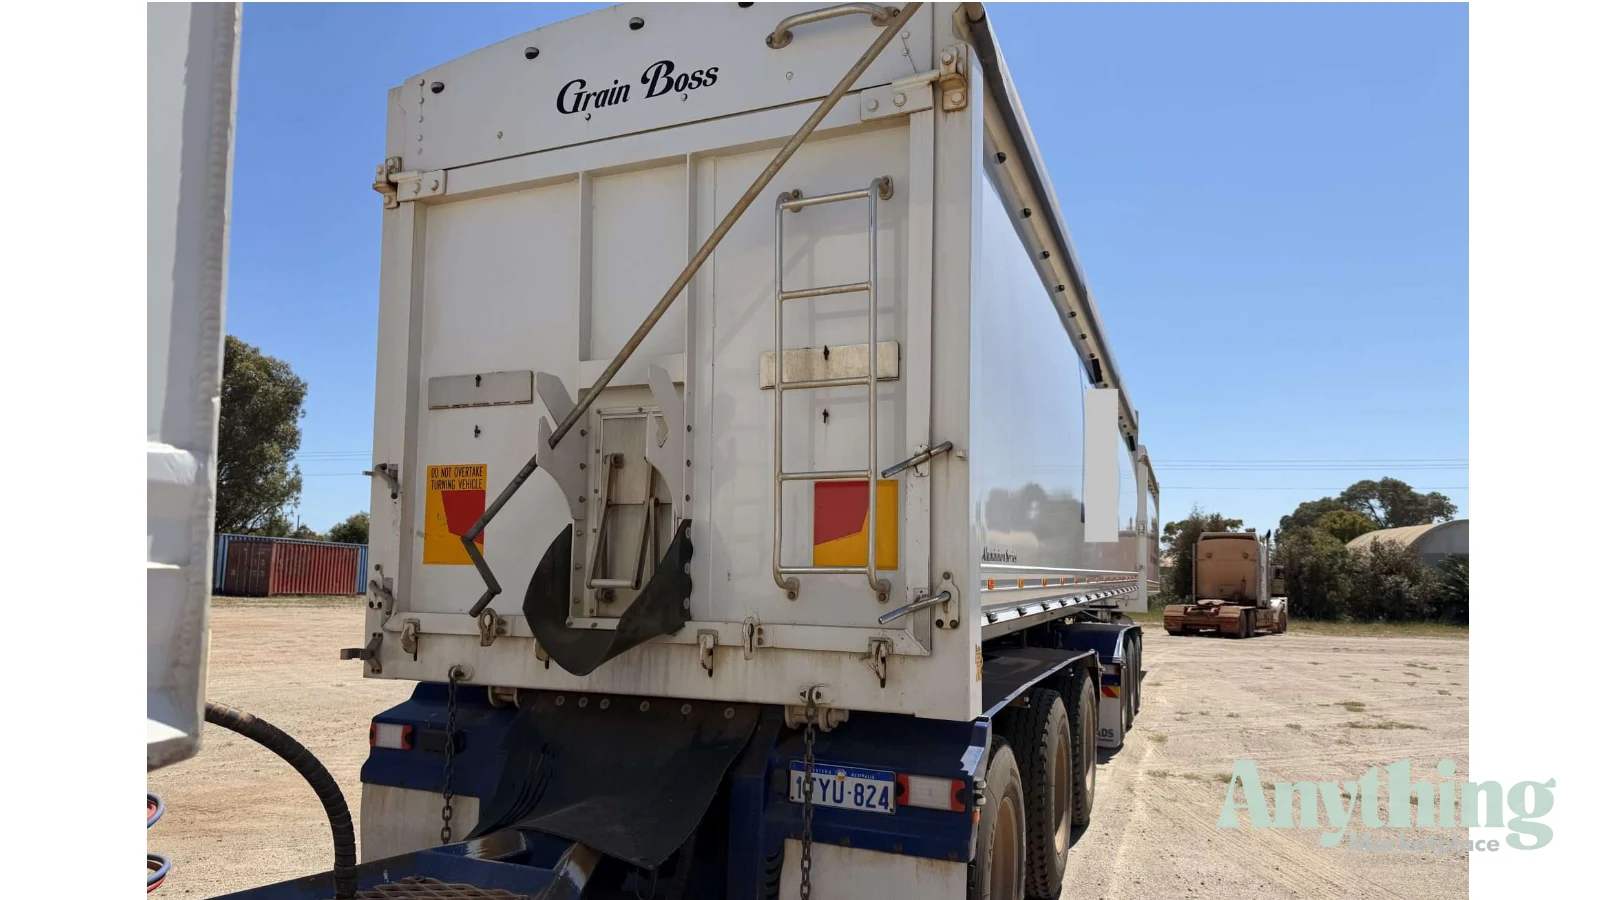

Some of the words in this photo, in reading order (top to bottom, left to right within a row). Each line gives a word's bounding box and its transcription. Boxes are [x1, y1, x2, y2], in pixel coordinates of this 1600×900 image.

[556, 78, 631, 115] Grain
[640, 60, 719, 99] Boss
[431, 467, 439, 478] DO
[441, 467, 452, 478] NOT
[454, 466, 483, 477] OVERTAKE
[431, 479, 456, 490] TURNING
[458, 478, 483, 489] VEHICLE
